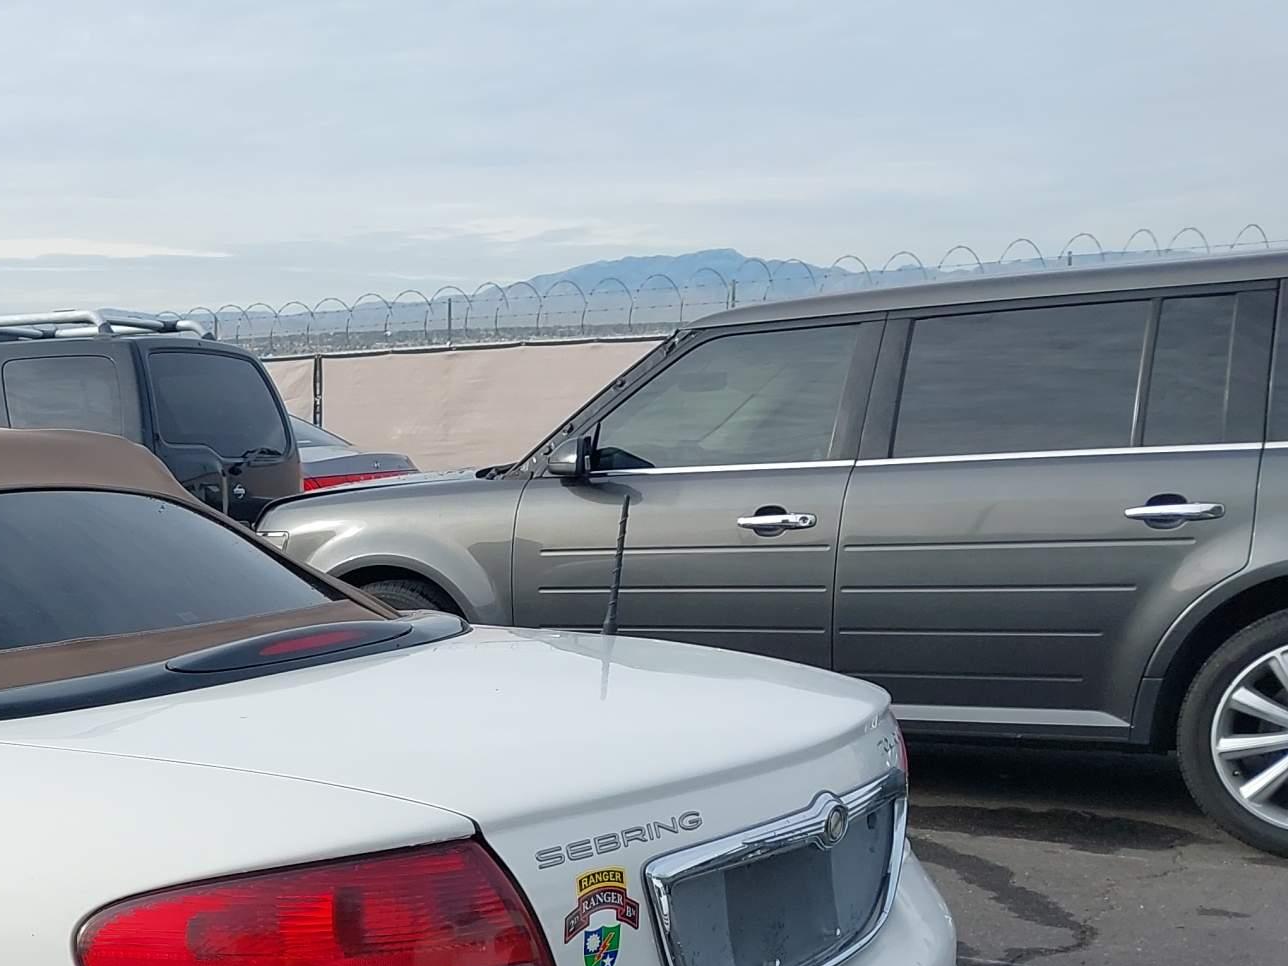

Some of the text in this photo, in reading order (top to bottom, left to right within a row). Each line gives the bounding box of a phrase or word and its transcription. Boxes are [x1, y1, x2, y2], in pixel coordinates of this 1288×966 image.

[535, 811, 703, 869] SEBRING
[580, 871, 622, 889] RANGER
[582, 892, 624, 913] RANGER
